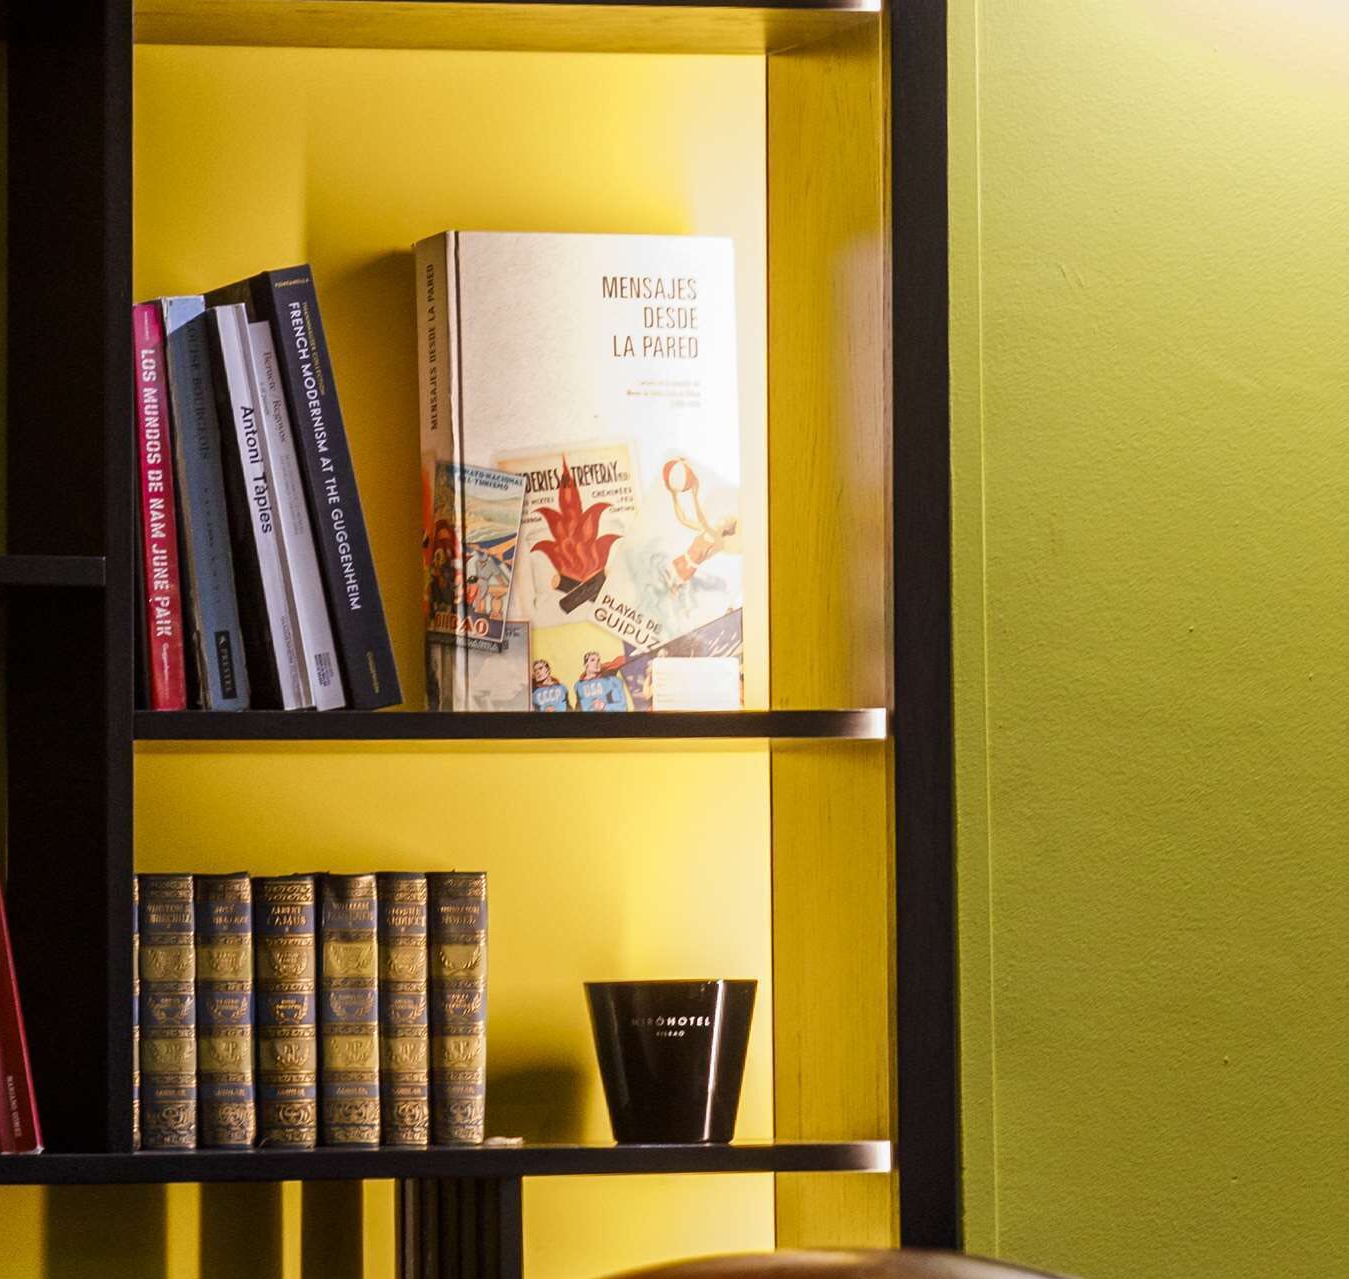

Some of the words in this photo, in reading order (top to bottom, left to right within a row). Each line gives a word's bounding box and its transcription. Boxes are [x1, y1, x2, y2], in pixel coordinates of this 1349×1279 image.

[426, 263, 435, 301] PARED
[602, 275, 698, 300] MENSAJES
[285, 301, 310, 360] FRENCH
[427, 307, 436, 321] LA
[643, 306, 699, 329] DESDE
[186, 327, 200, 369] OUISE
[427, 326, 436, 361] DESDE
[613, 334, 635, 358] LA
[642, 334, 700, 359] PARED
[139, 349, 157, 382] LOS
[192, 377, 210, 459] BOURGEOIS
[298, 363, 329, 452] MODERNISM
[428, 366, 437, 429] MENSAJES
[141, 387, 161, 464] MUNDOS
[240, 404, 263, 464] Antoni
[146, 469, 163, 492] DE
[318, 455, 333, 473] AT
[249, 471, 275, 534] Tàpies
[322, 477, 340, 505] THE
[148, 498, 166, 538] NAM
[150, 543, 168, 590] JUNE
[328, 507, 362, 611] GUGGENHEIM
[153, 596, 171, 637] PAIK
[602, 594, 644, 625] PLAYAS
[645, 618, 664, 635] DE
[219, 647, 233, 692] PRESTEL
